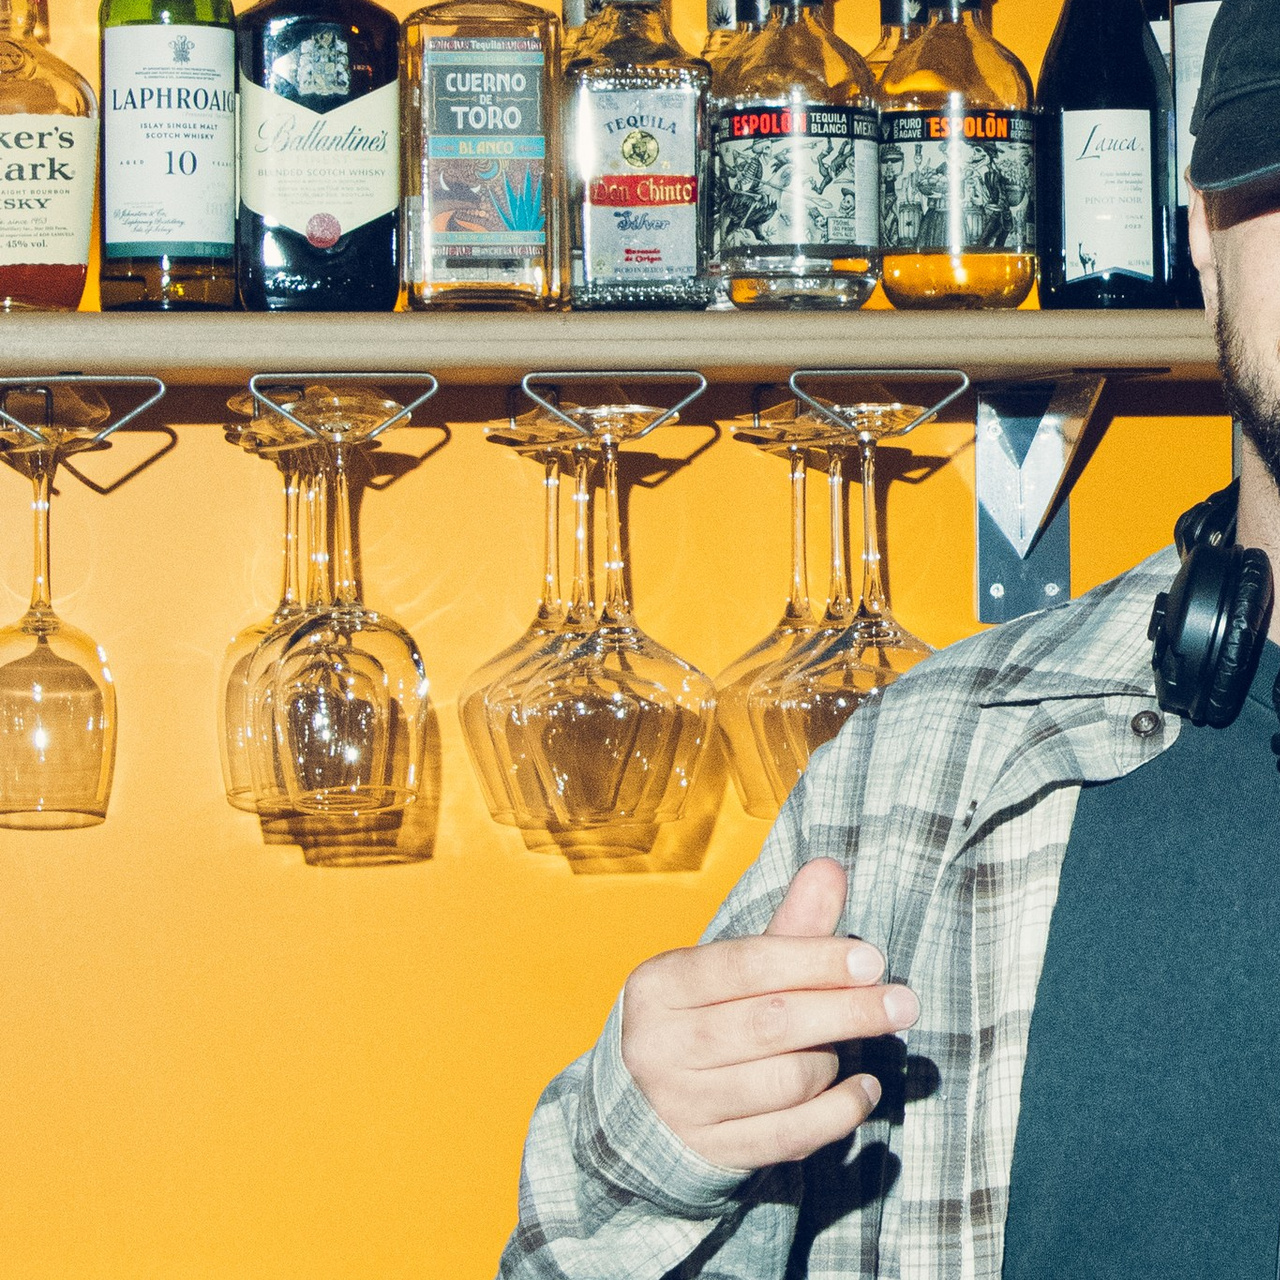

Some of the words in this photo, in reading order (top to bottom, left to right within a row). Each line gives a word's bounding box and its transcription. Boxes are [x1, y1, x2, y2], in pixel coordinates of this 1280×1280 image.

[470, 40, 503, 51] Tequila
[446, 72, 527, 92] CUERNO
[112, 86, 235, 113] LAPHROAIG
[479, 94, 493, 106] DE
[450, 106, 523, 130] TORO
[810, 112, 847, 124] TEQUILA
[899, 117, 922, 129] PURO
[166, 122, 197, 130] SINGLE
[200, 123, 219, 131] MALT
[603, 115, 677, 134] TEQUILA
[810, 122, 847, 135] BLANCO
[183, 132, 215, 140] WHISKY
[254, 113, 389, 154] Ballantine's
[899, 128, 922, 139] AGAVE
[458, 141, 515, 154] BLANCO
[0, 156, 74, 181] ark
[164, 150, 198, 176] 10
[306, 168, 346, 177] SCOTCH
[349, 168, 386, 177] WHISKY
[636, 177, 693, 202] Chinto
[0, 198, 52, 210] SKY
[1085, 196, 1116, 205] PINOT
[1118, 196, 1142, 205] NOIR
[613, 210, 671, 231] Silver
[7, 239, 29, 249] 45%
[31, 238, 49, 249] vol.
[635, 255, 662, 264] Origen
